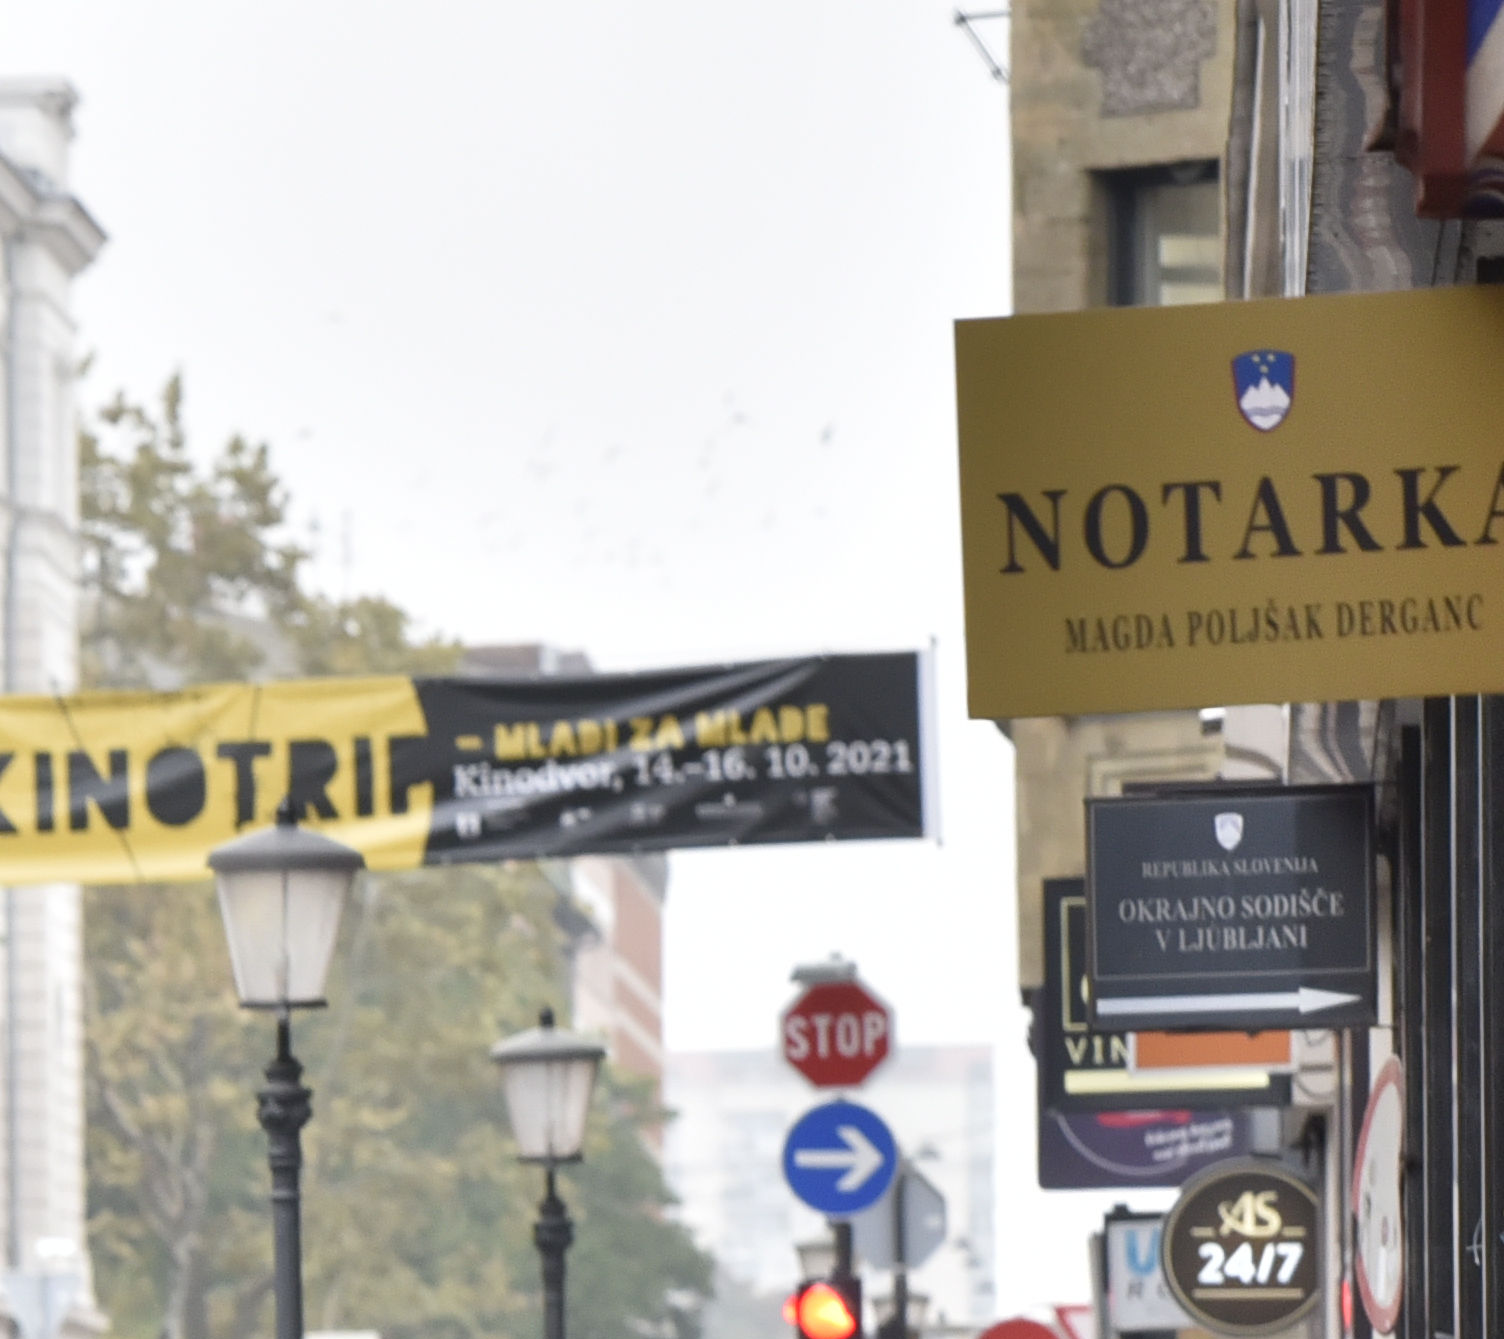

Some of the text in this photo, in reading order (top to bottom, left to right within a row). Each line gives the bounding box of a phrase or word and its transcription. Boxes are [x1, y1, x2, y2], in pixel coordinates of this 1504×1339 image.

[1065, 594, 1484, 654] MAGDA POLJŠAK DERGANC
[494, 703, 831, 761] MLADI ZA MLADE
[766, 745, 820, 779] 10.
[827, 739, 913, 776] 2021
[1141, 856, 1320, 879] REPUBLIKA SLOVENIJA
[1118, 887, 1345, 923] OKRAJNO SODIŠČE
[1155, 923, 1308, 951] V LJUBLJANI
[787, 1010, 886, 1060] STOP
[1196, 1241, 1304, 1285] 24/7
